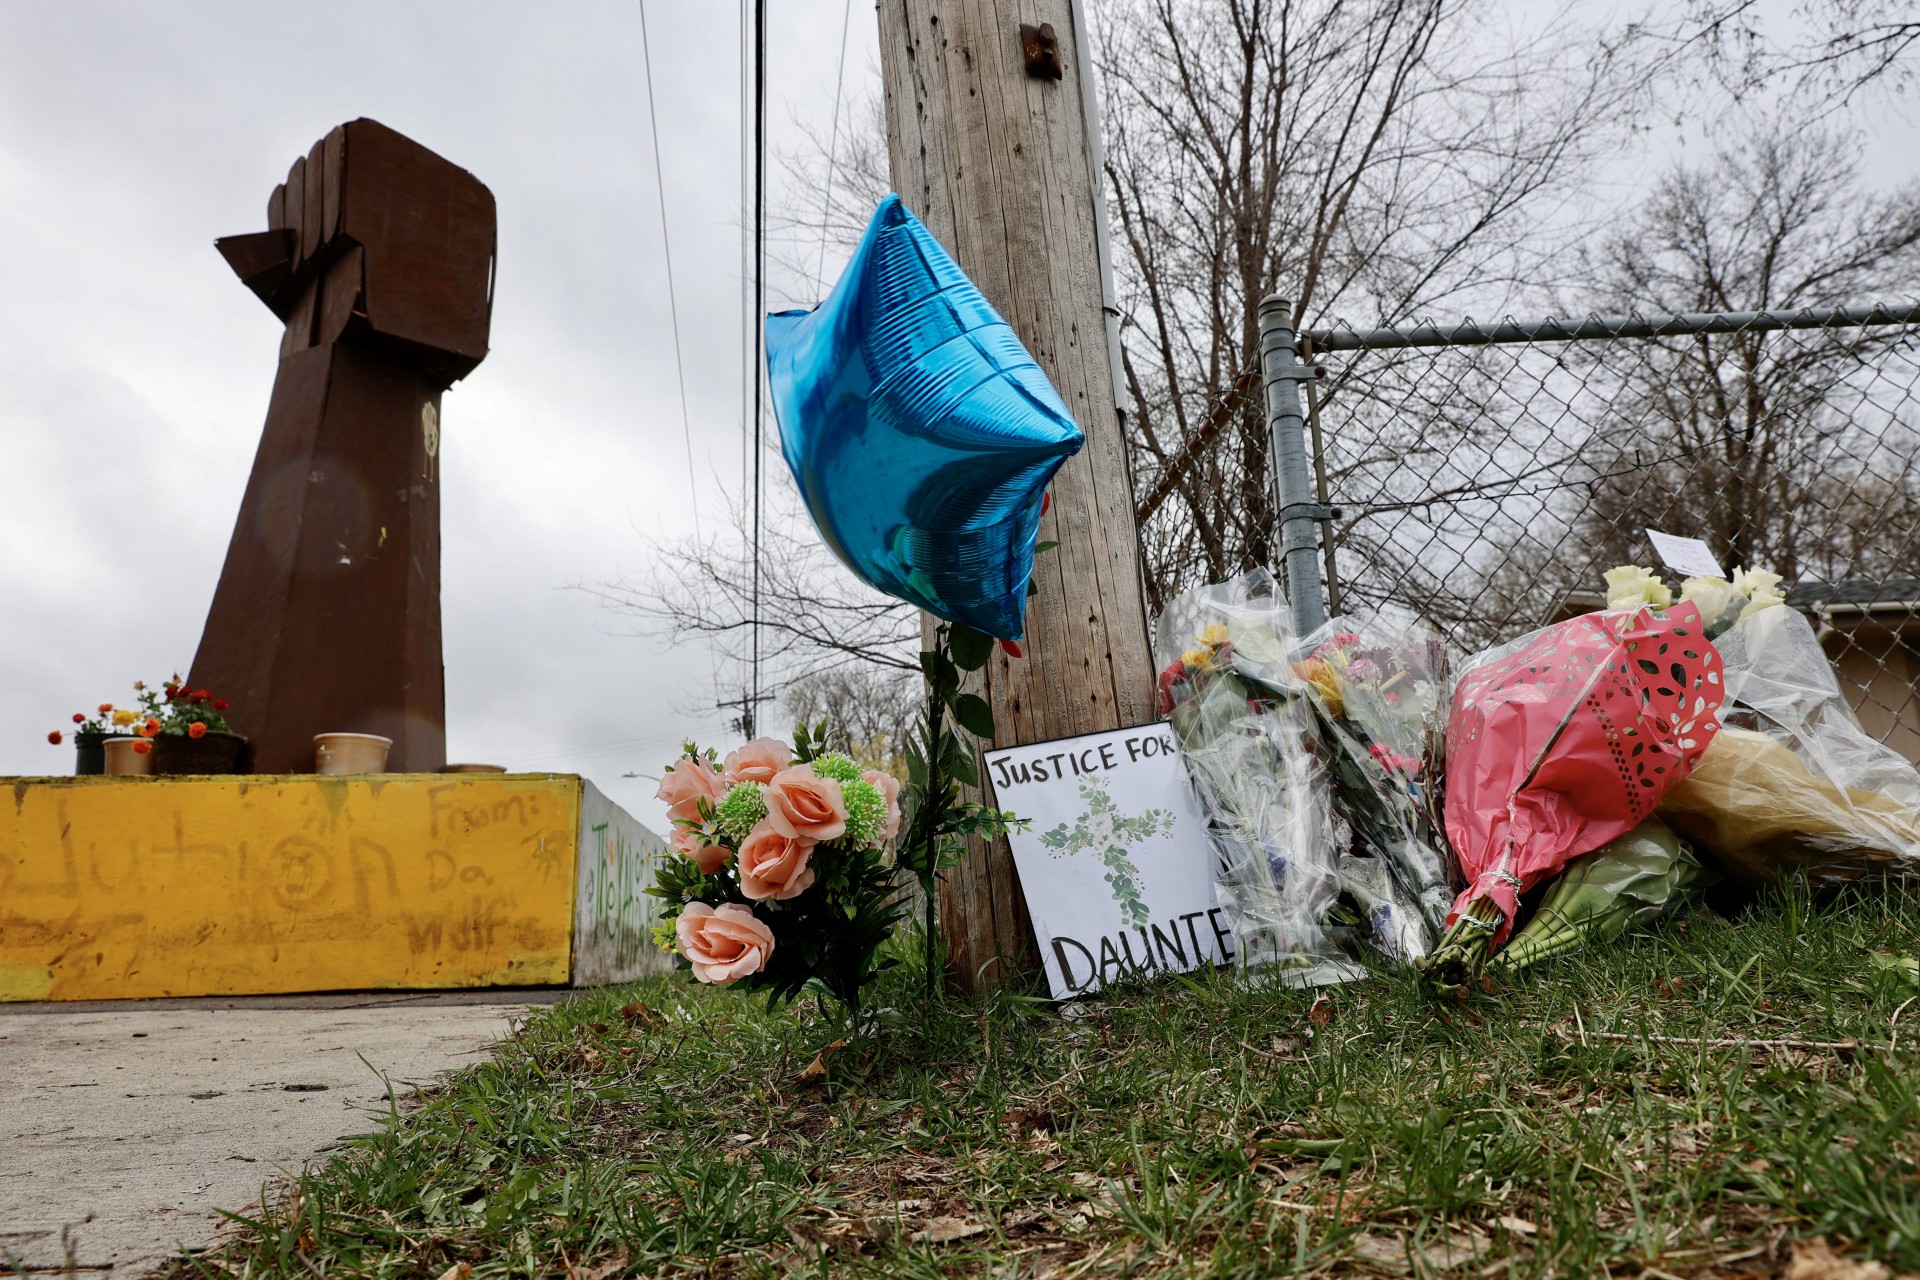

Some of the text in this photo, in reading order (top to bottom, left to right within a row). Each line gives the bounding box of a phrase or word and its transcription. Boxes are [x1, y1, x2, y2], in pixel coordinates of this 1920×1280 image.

[991, 734, 1176, 789] JUSTICE FOR
[1051, 907, 1236, 992] DAUNTE
